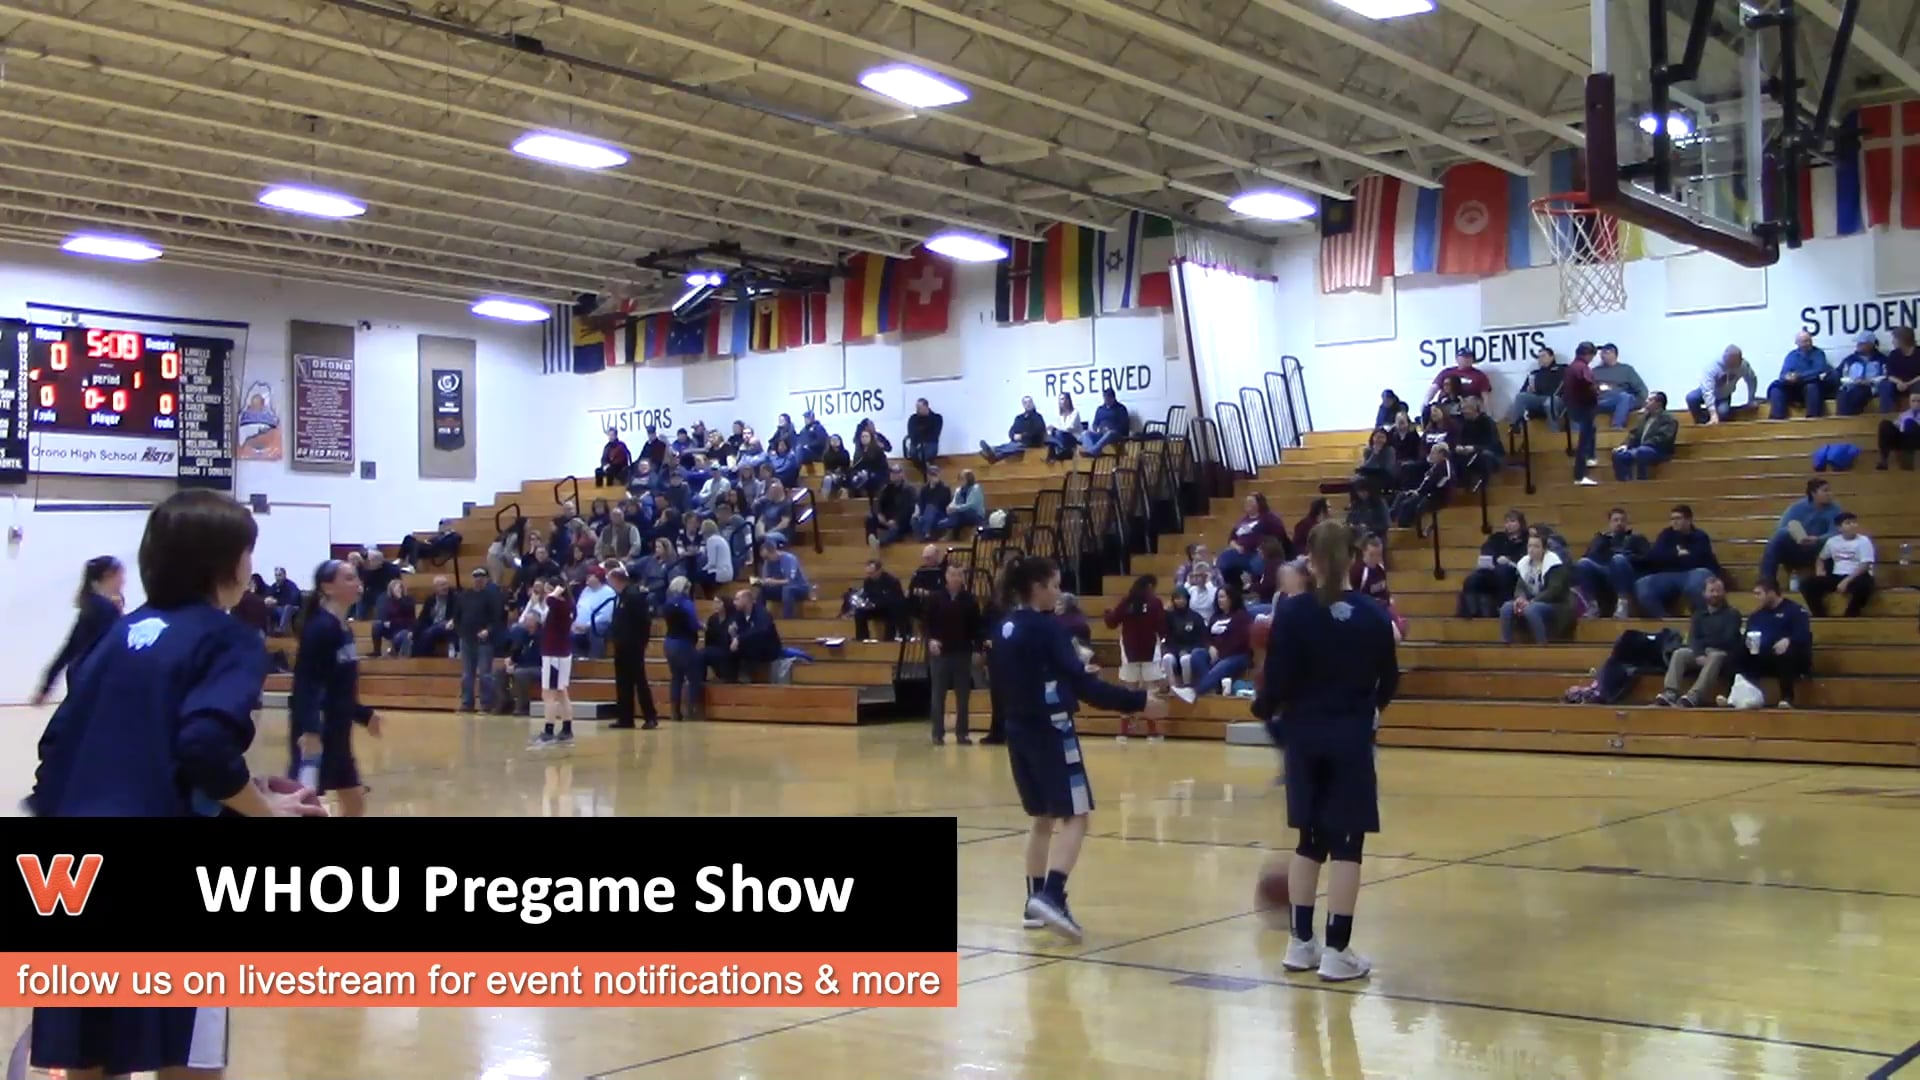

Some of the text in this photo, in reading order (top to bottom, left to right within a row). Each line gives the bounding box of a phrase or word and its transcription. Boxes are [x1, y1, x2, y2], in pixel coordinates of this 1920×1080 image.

[1801, 298, 1920, 336] STUDEN
[51, 342, 68, 370] 0
[1419, 331, 1545, 367] STUDENTS
[161, 352, 178, 379] 0
[92, 374, 121, 386] period
[1045, 365, 1152, 398] RESERVED
[40, 385, 55, 407] 0
[112, 390, 127, 412] 0
[159, 394, 173, 415] 0
[805, 388, 884, 417] VISITORS
[91, 411, 121, 426] player
[600, 407, 673, 436] VISITORS
[70, 449, 97, 463] High
[100, 450, 138, 462] School
